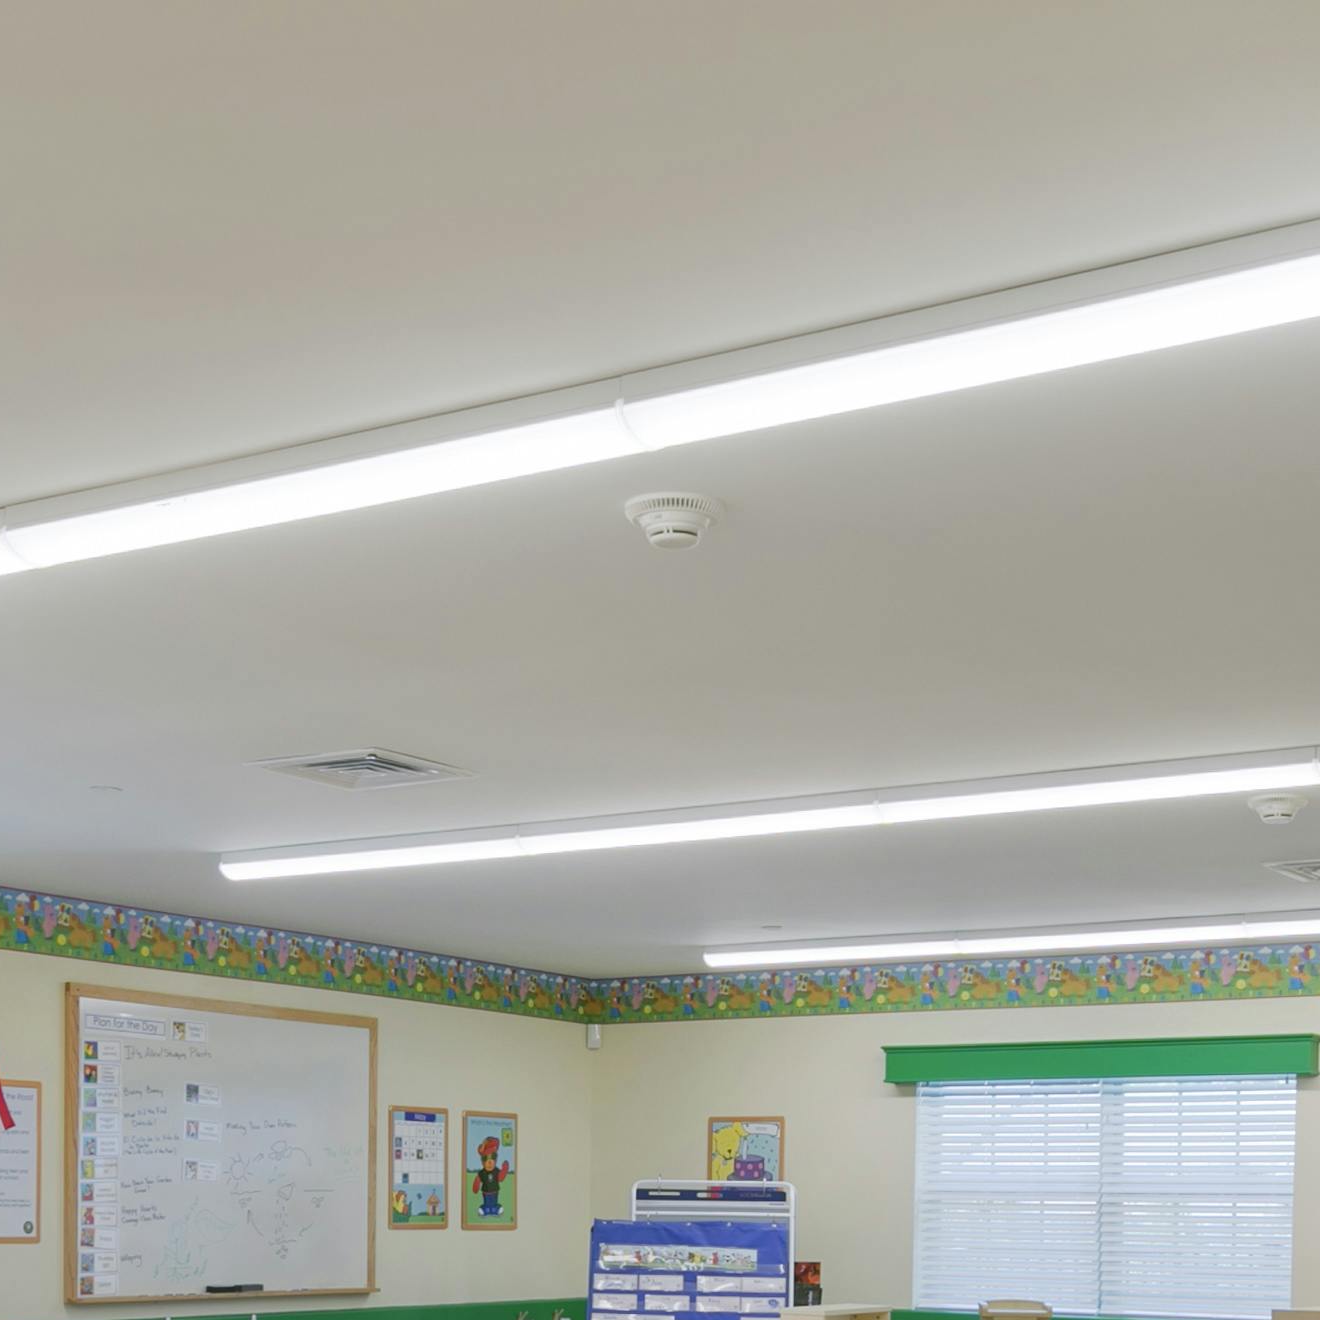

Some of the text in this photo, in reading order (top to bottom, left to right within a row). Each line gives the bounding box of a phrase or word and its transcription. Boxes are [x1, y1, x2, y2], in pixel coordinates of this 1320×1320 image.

[93, 1015, 111, 1027] Plan
[126, 1019, 141, 1030] the
[143, 1022, 158, 1034] Day
